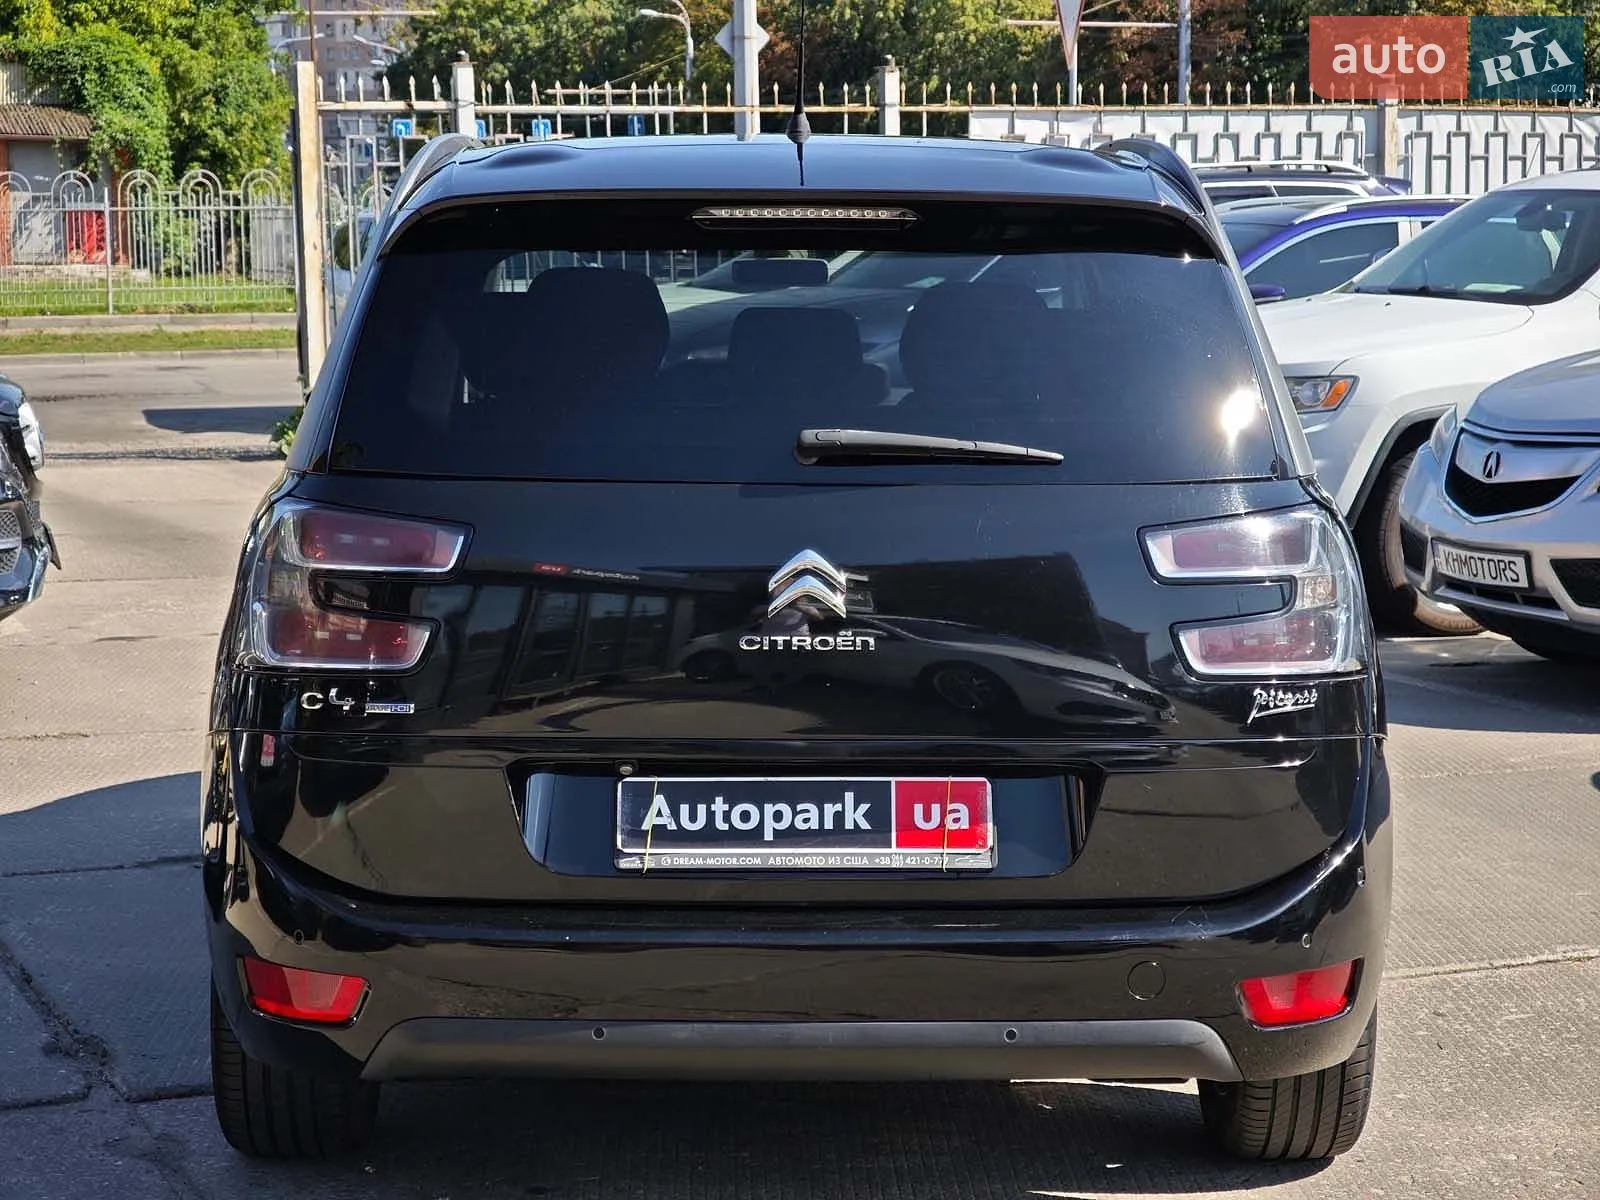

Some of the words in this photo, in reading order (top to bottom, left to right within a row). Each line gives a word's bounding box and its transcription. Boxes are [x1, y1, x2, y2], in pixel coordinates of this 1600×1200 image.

[1443, 549, 1520, 583] KHMOTORS
[300, 687, 355, 712] C4
[640, 791, 872, 841] Autopark
[913, 801, 971, 830] ua
[673, 857, 762, 866] DREAM-MOTOR.COM
[768, 856, 825, 866] АВТОМОТО
[829, 856, 840, 865] ИЗ
[843, 856, 869, 865] США
[874, 856, 891, 865] +38
